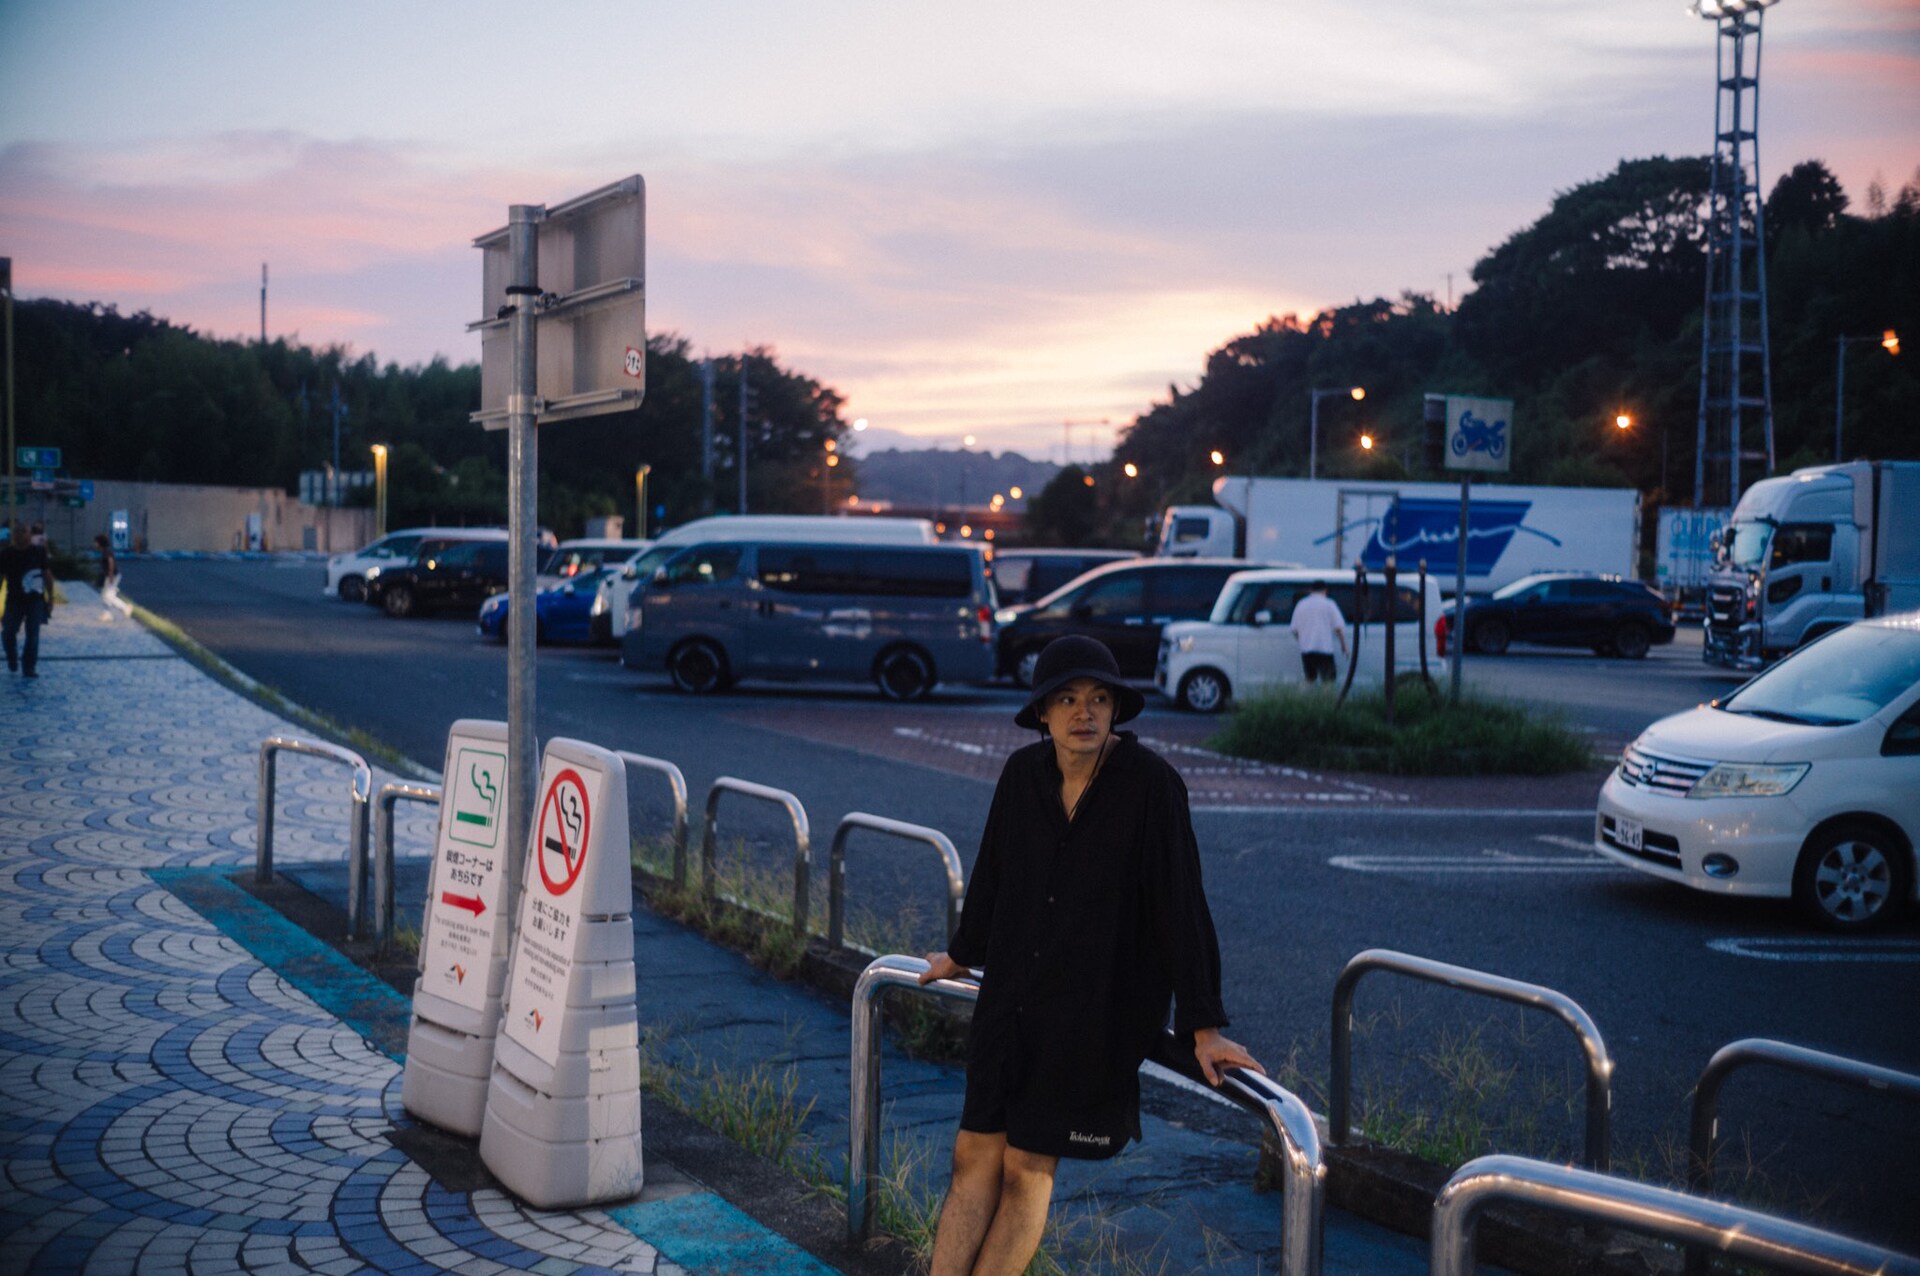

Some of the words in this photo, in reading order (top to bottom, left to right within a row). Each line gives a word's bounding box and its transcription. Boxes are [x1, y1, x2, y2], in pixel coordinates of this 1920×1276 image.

[446, 850, 493, 872] 喫煙コーナーは
[532, 916, 566, 941] お願いします
